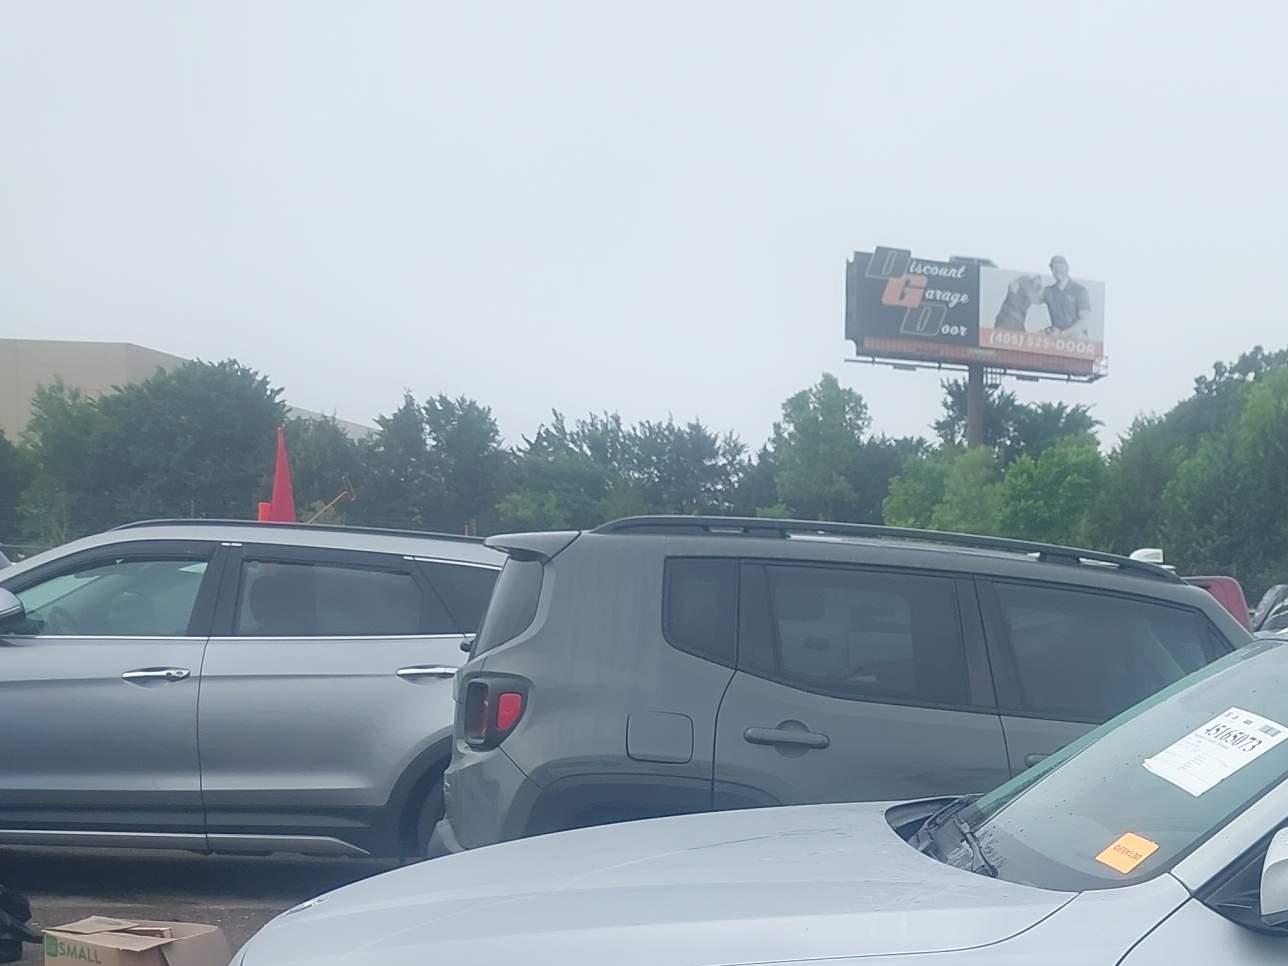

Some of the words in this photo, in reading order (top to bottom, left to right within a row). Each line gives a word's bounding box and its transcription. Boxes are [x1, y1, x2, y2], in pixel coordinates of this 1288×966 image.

[866, 246, 967, 280] Discount
[881, 275, 969, 309] Garage
[900, 302, 968, 336] Door
[989, 331, 1024, 347] (405)
[1204, 722, 1263, 753] 45165073
[58, 941, 102, 964] SMALL
